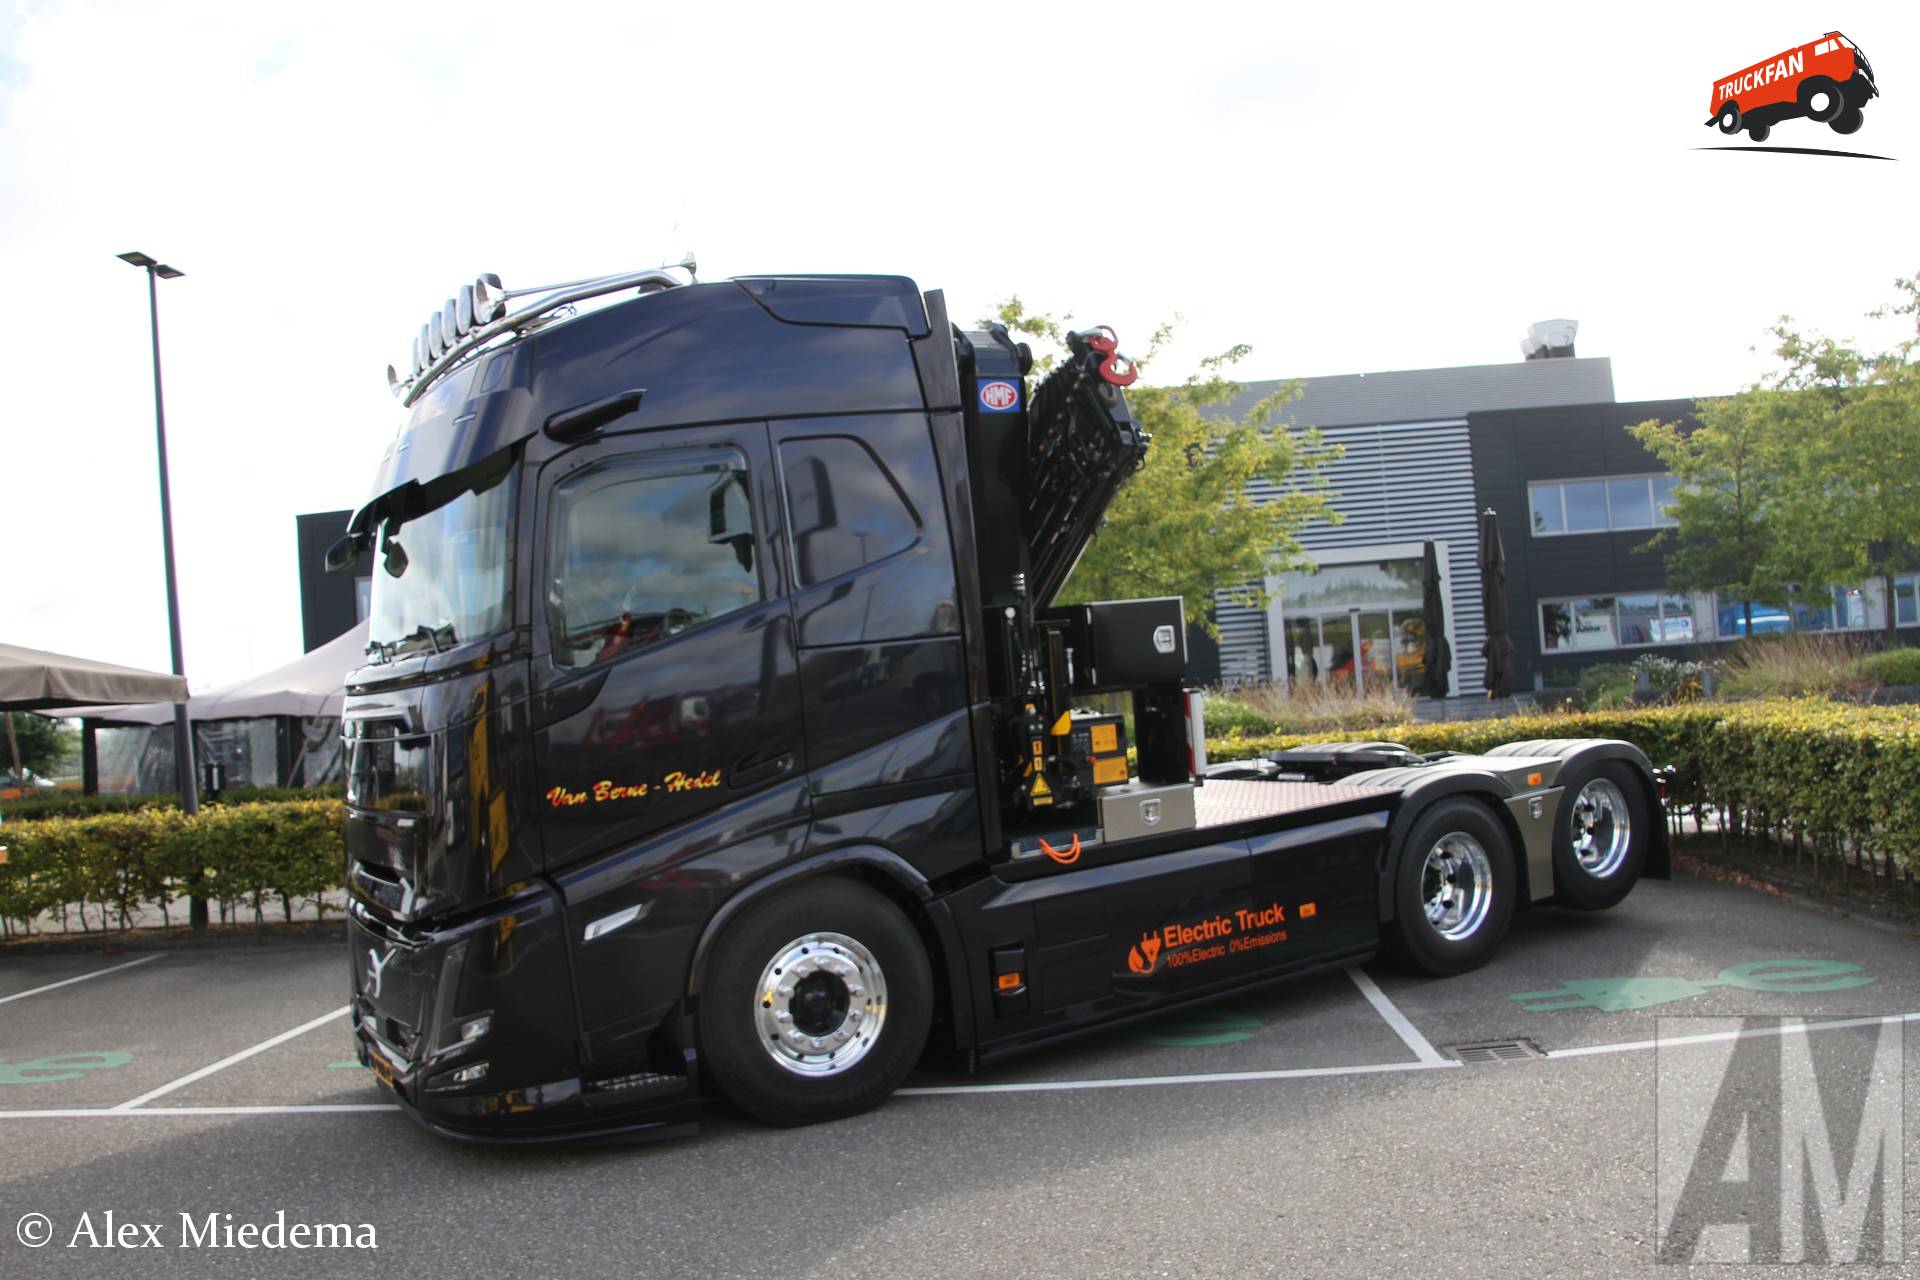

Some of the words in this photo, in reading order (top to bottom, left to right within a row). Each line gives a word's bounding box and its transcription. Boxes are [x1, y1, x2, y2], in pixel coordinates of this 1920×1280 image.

[985, 386, 1013, 406] HMF
[546, 786, 588, 808] Van
[593, 780, 649, 802] Berne
[664, 770, 721, 793] Hedel
[1163, 915, 1233, 948] Electric
[1235, 902, 1285, 931] Truck
[1166, 944, 1225, 968] 100%Electric
[1229, 930, 1288, 953] 0%Emissions
